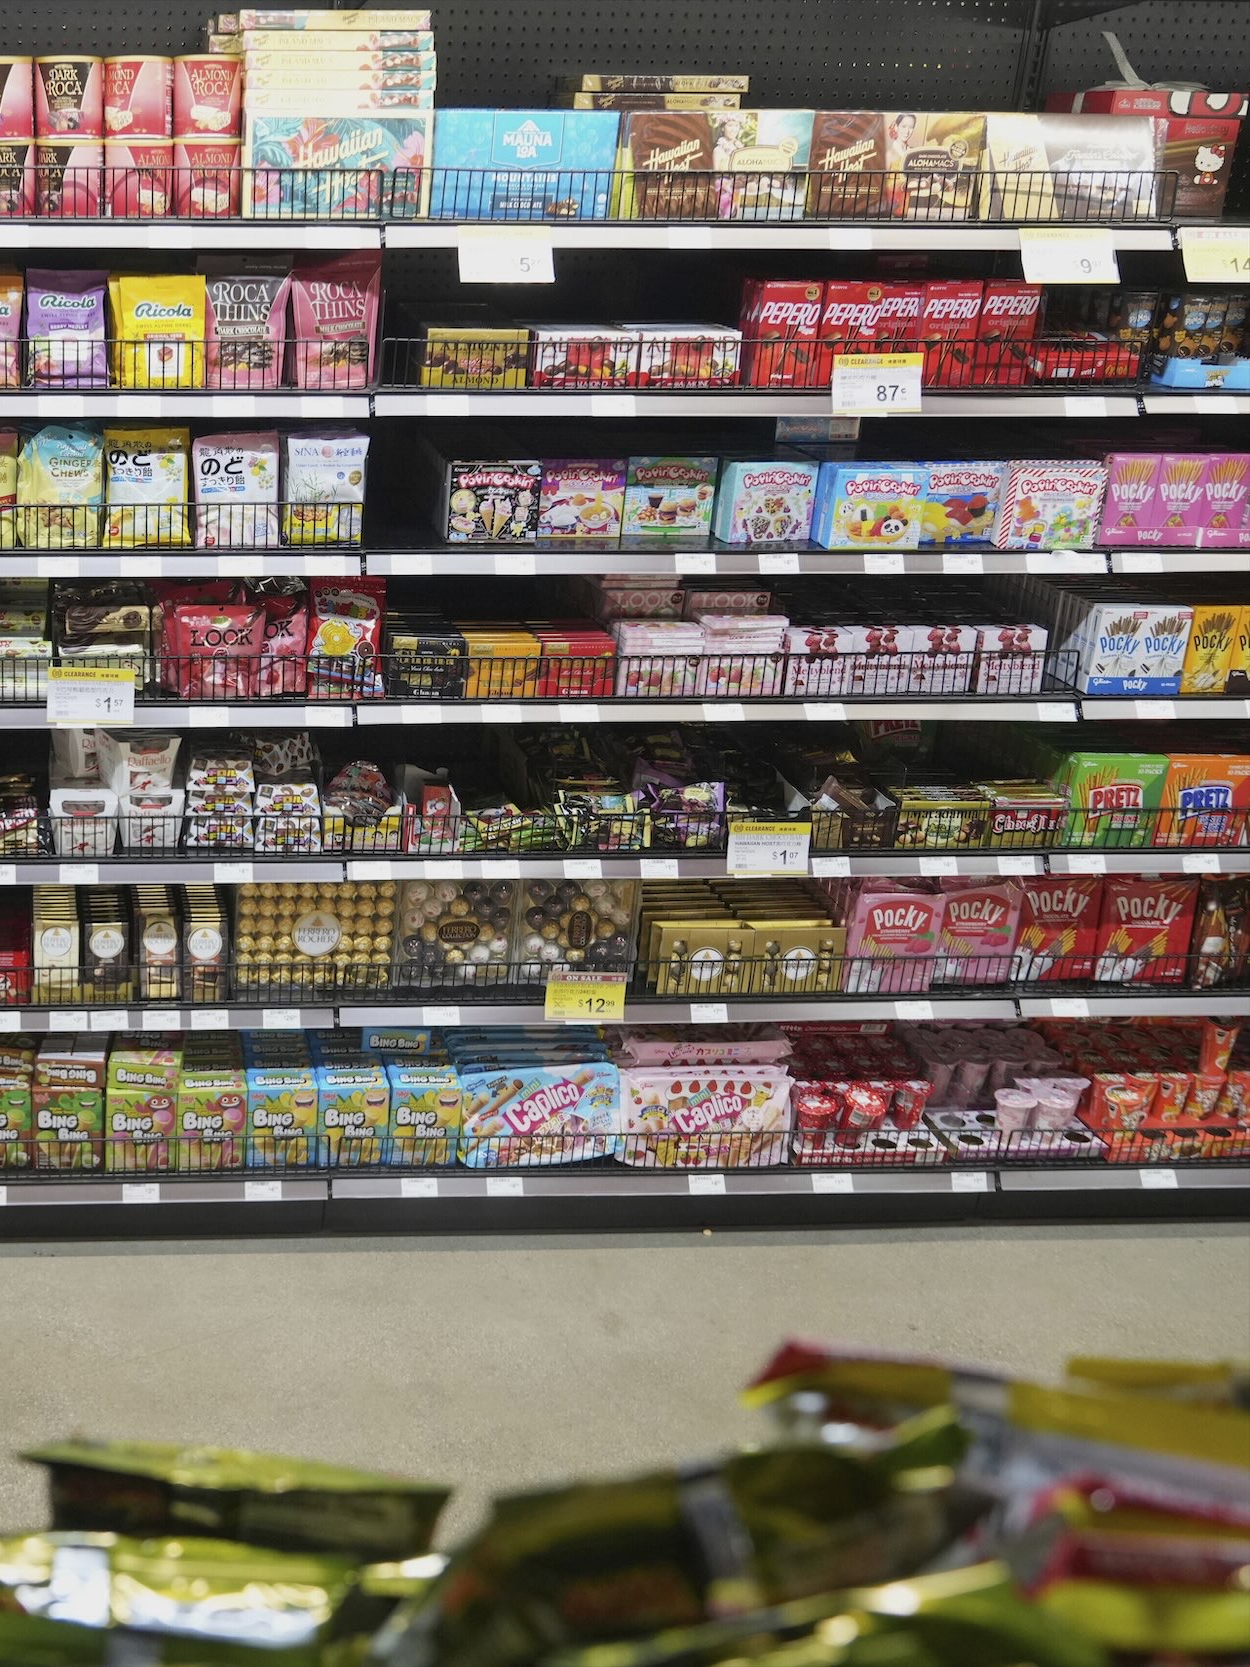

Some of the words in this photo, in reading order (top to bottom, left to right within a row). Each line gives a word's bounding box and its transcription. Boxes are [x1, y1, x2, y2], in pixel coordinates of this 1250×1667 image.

[49, 69, 78, 81] DARK
[191, 69, 233, 82] ALMOND
[46, 81, 82, 96] ROCA
[194, 82, 231, 96] ROCA
[503, 133, 553, 147] MAUNA
[191, 152, 233, 164] ALMOND
[296, 125, 384, 178] Hawaiian
[517, 145, 538, 158] LOA
[644, 138, 701, 167] Hawaiian
[818, 138, 875, 167] Hawaiian
[658, 152, 704, 184] Host
[833, 152, 877, 184] Host
[492, 173, 556, 183] MOUNTAINS
[499, 201, 516, 209] MILK
[520, 257, 531, 272] 5
[1080, 258, 1092, 274] 9
[212, 282, 270, 303] ROCA
[310, 281, 362, 302] ROCA
[40, 294, 97, 309] Ricola
[983, 294, 1041, 316] PEPERO
[136, 302, 194, 317] Ricola
[207, 301, 271, 323] THINS
[306, 300, 367, 321] THINS
[758, 301, 822, 327] PEPERO
[823, 303, 882, 329] PEPERO
[923, 298, 982, 321] PEPERO
[217, 328, 238, 338] DARK
[239, 327, 268, 338] CHOCOLATE
[851, 358, 883, 367] CLEARANCE
[109, 450, 152, 467] のど
[294, 446, 320, 457] SINA
[49, 457, 91, 468] GINGER
[200, 458, 244, 476] のど
[51, 467, 90, 478] CHEWS
[702, 593, 756, 608] LOOK
[191, 628, 253, 647] LOOK
[127, 754, 172, 768] Raffaello
[1091, 785, 1142, 811] PRETZ
[1180, 785, 1231, 815] PRETZ
[297, 928, 335, 936] FERRERO
[442, 925, 477, 934] FERRERO
[566, 974, 579, 982] ON
[581, 974, 602, 982] SALE
[690, 1089, 710, 1105] mini
[506, 1082, 580, 1132] Caplico
[673, 1095, 742, 1131] Caplico
